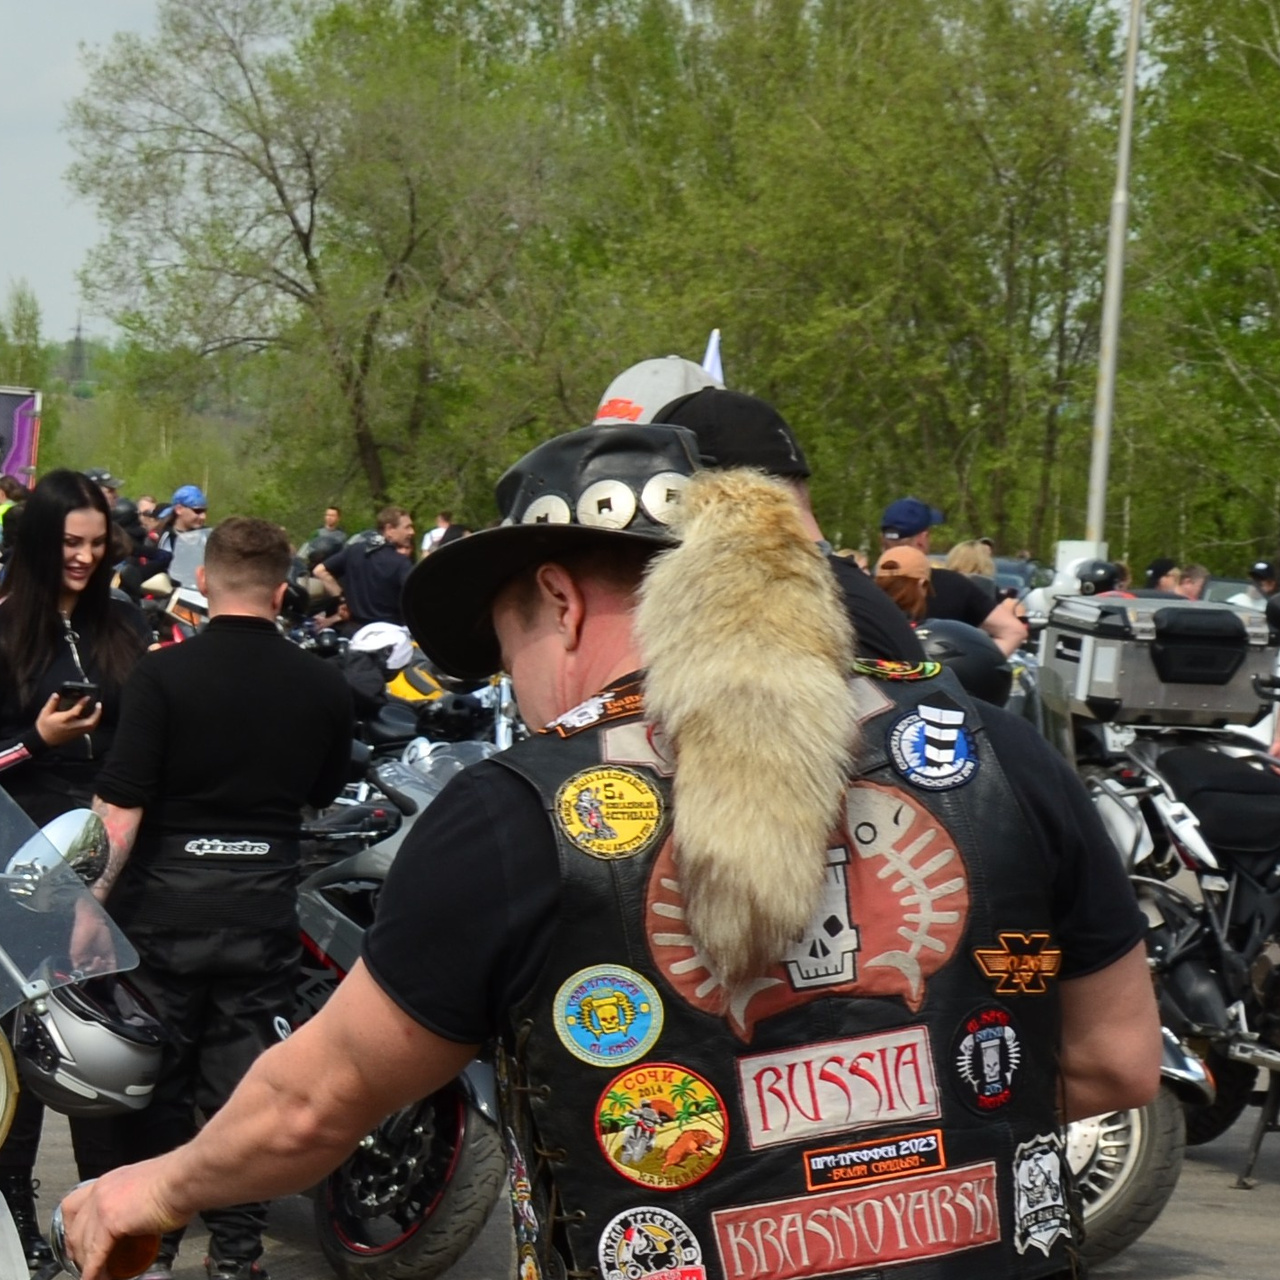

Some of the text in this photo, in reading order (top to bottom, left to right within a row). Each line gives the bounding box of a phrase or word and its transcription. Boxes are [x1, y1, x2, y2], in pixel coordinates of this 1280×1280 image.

[623, 1069, 675, 1091] СОЧИ
[752, 1041, 928, 1133] RUSSIA
[638, 1085, 663, 1098] 2014
[899, 1135, 937, 1155] 2023
[725, 1178, 995, 1277] KRASNOYARSK
